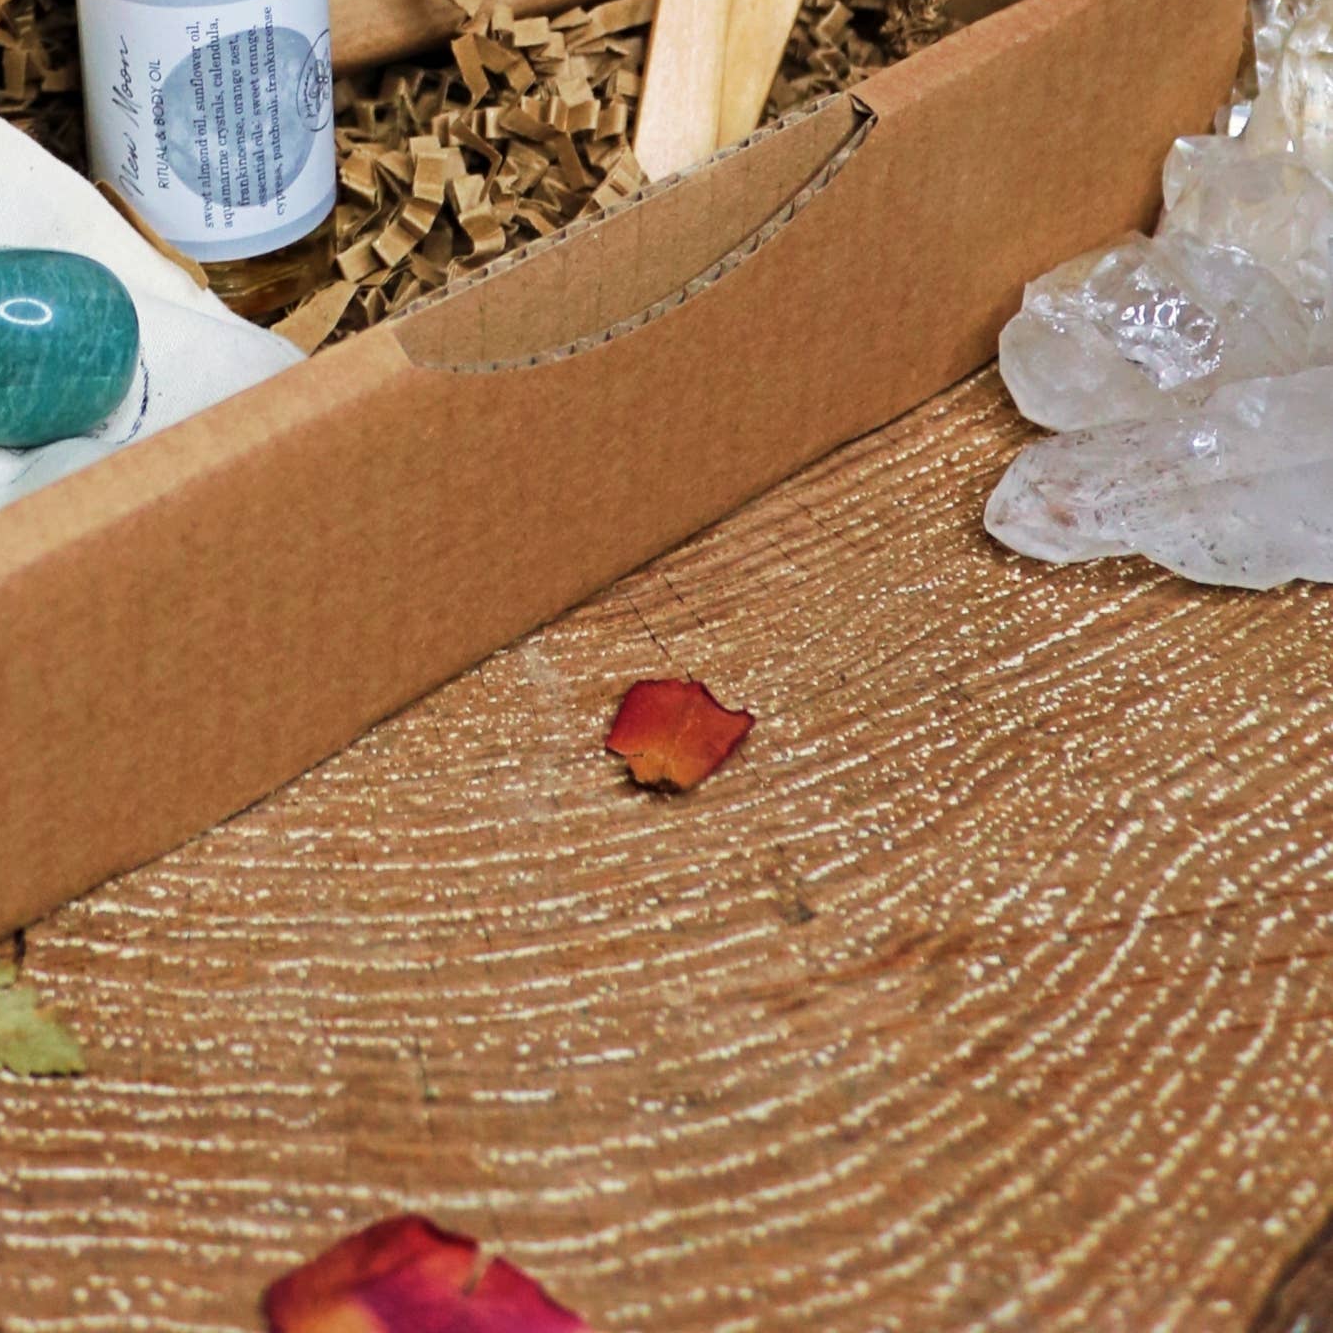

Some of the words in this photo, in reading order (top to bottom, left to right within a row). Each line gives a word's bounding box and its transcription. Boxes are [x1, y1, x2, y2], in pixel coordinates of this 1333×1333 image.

[185, 21, 201, 43] oil,
[205, 17, 224, 88] calendula,
[227, 33, 241, 66] zest,
[263, 6, 278, 93] frankincense
[112, 35, 140, 129] Moon
[148, 58, 162, 83] OIL
[189, 45, 206, 112] sunflower
[231, 68, 245, 115] orange
[150, 85, 167, 128] BODY
[211, 90, 230, 147] crystals,
[249, 77, 262, 117] sweet
[192, 114, 207, 137] oil,
[119, 133, 144, 199] New
[155, 143, 170, 190] RITUAL
[194, 138, 212, 189] almond
[253, 149, 268, 208] essential
[200, 191, 215, 229] sweet
[219, 150, 235, 230] aquamarine
